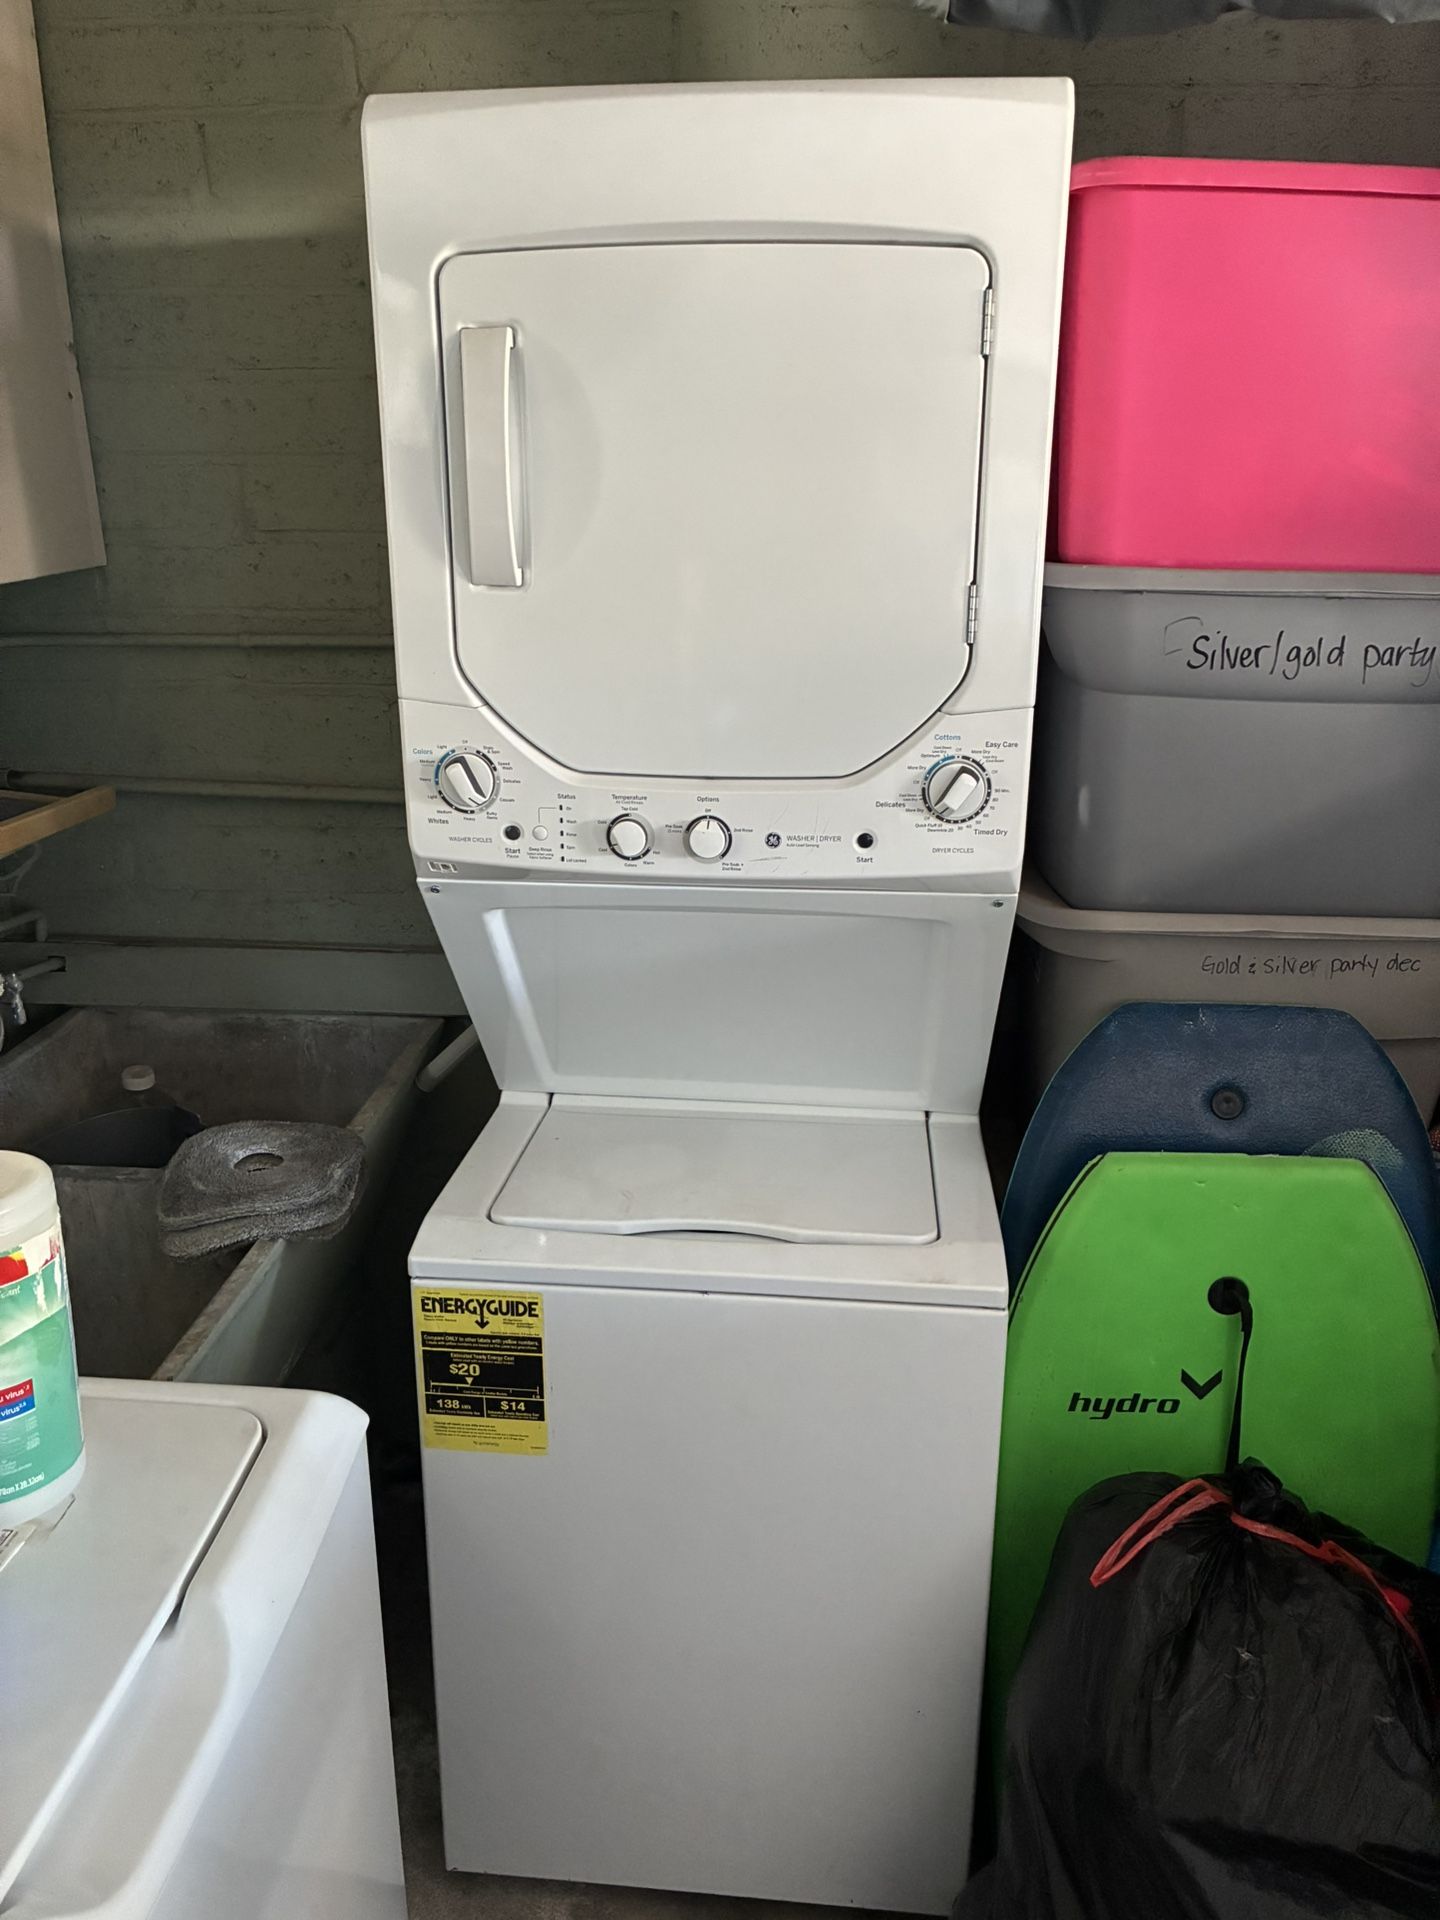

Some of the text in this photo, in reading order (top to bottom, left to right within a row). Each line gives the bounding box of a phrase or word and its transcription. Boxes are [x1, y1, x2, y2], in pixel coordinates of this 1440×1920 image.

[1186, 630, 1436, 687] Silver/gold party
[985, 741, 1001, 749] Easy
[995, 829, 1008, 837] Dry
[1202, 955, 1241, 975] Gold
[1330, 954, 1378, 979] party
[1387, 953, 1422, 973] dec
[421, 1296, 539, 1318] ENERGYGUIDE
[449, 1363, 480, 1376] $20
[437, 1399, 460, 1409] 138
[500, 1401, 526, 1411] $14
[1068, 1392, 1181, 1420] hydro
